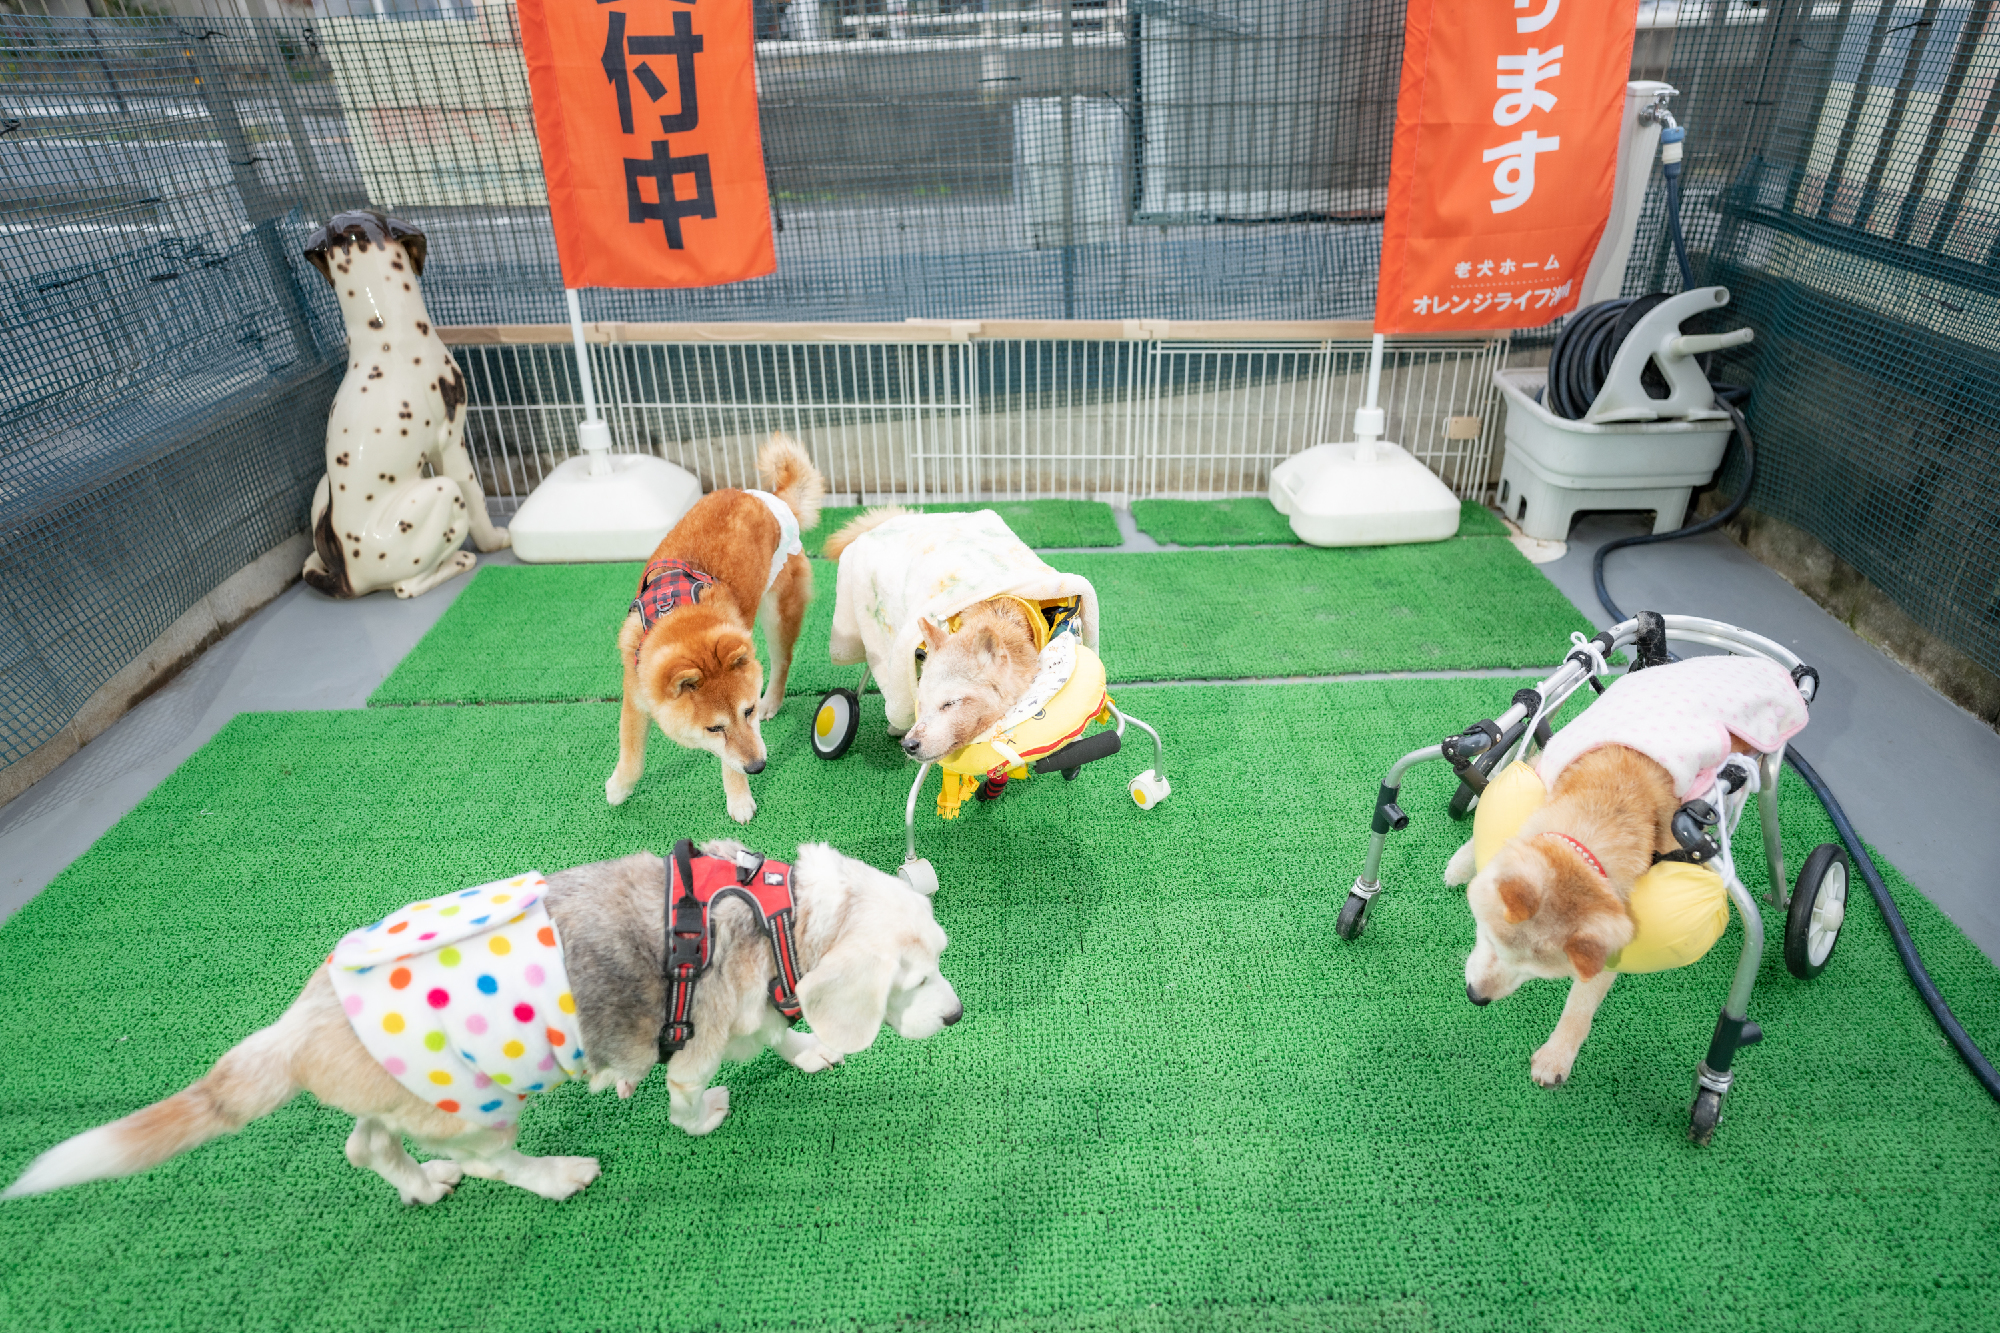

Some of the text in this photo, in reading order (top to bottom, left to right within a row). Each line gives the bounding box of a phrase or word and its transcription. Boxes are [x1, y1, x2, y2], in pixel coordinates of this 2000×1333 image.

[597, 0, 717, 250] 付中
[1454, 254, 1560, 279] 老犬ホーム
